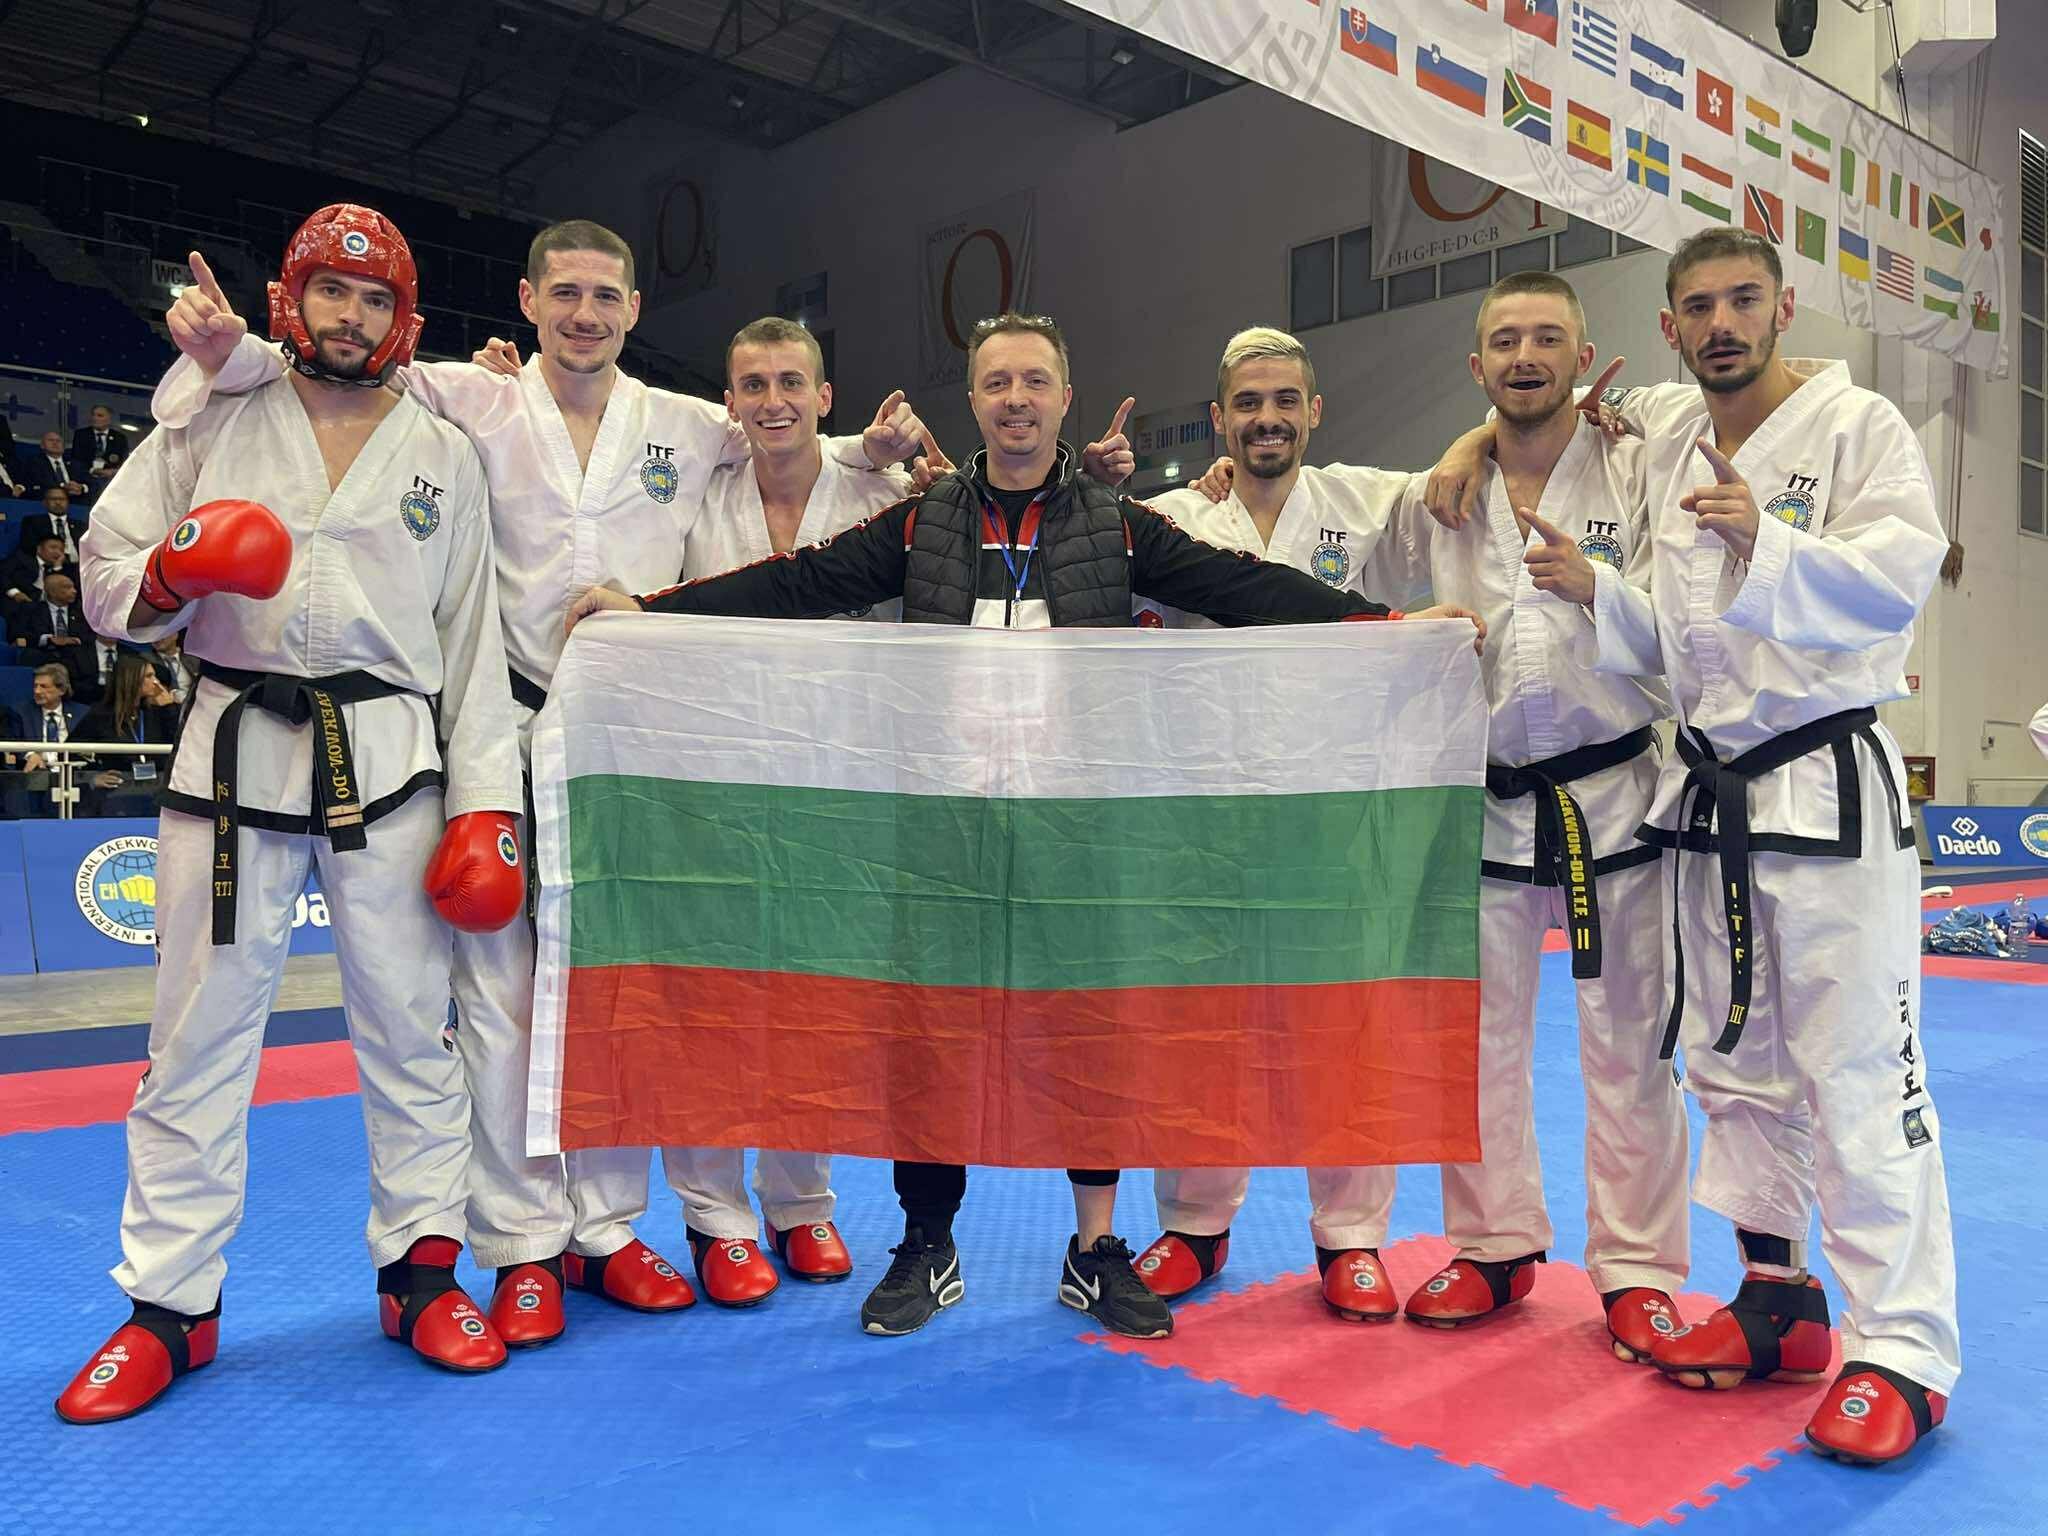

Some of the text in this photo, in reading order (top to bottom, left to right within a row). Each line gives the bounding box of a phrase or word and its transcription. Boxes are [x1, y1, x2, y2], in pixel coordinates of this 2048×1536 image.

[647, 443, 675, 459] ITF
[413, 475, 444, 498] ITF
[1787, 473, 1819, 491] ITF
[1320, 527, 1347, 543] ITF
[1586, 520, 1618, 535] ITF
[1937, 834, 2001, 856] Daedo
[78, 838, 159, 941] INTERNATIONAL TAEKWO
